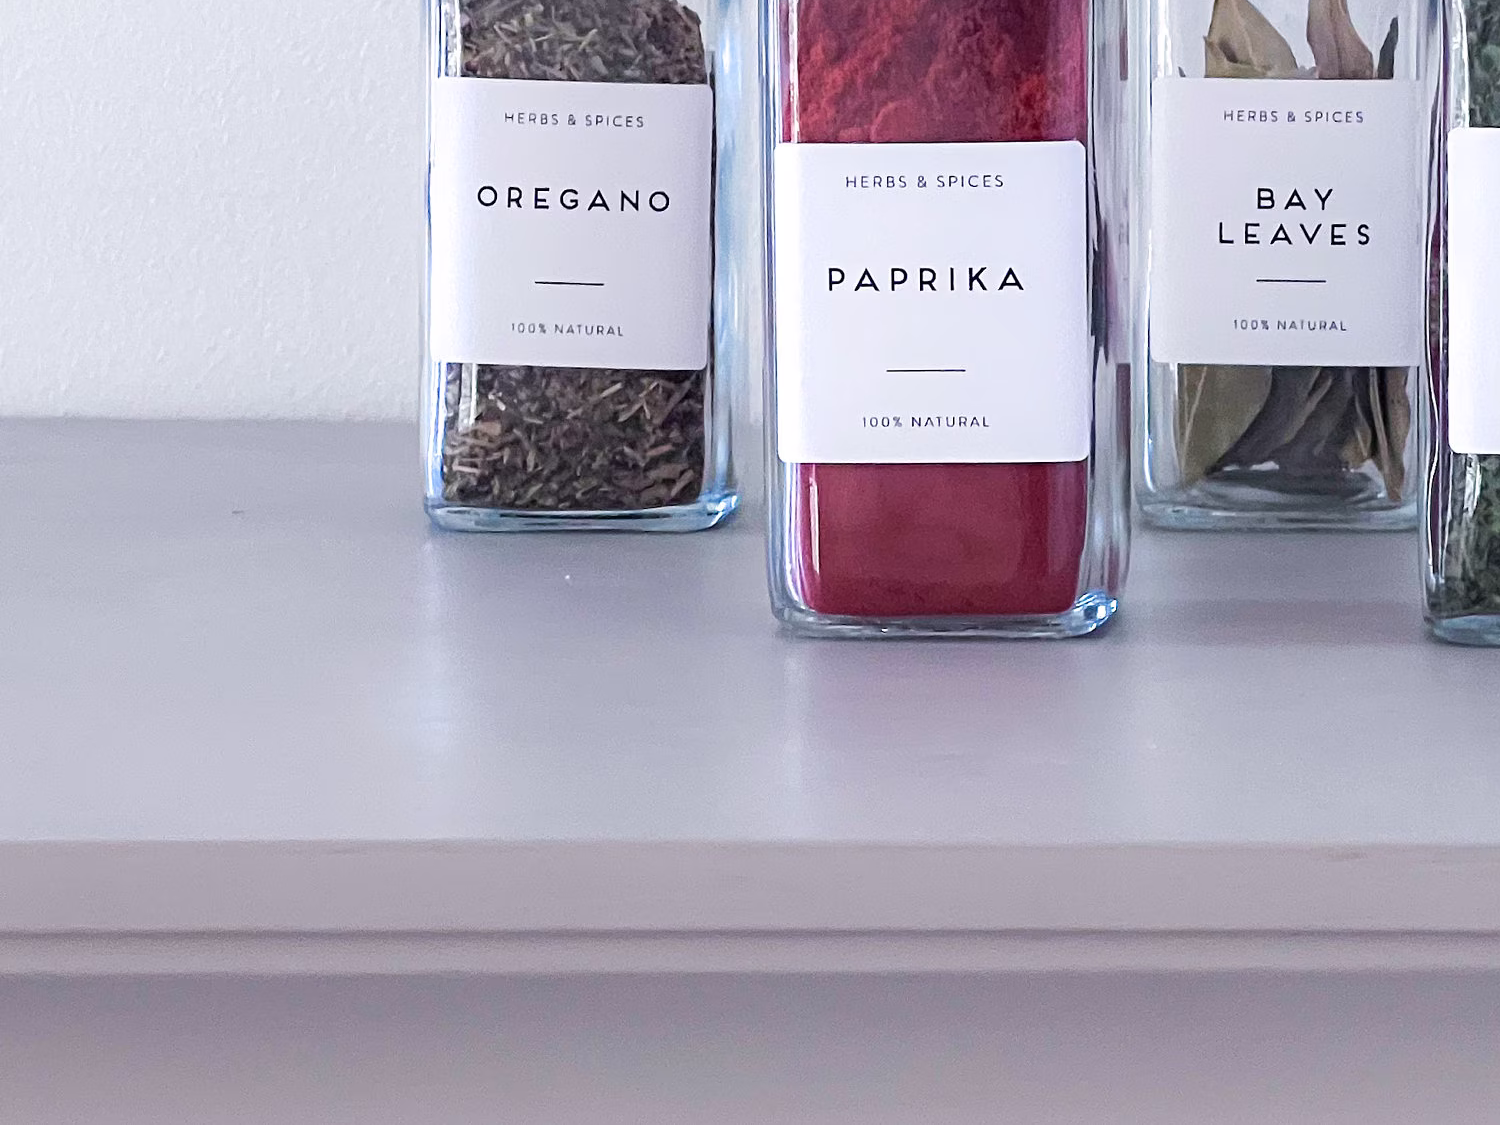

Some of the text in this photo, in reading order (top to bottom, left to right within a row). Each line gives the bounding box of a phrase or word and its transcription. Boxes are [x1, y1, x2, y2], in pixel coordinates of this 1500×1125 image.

[504, 112, 645, 129] HERBS & SPICES
[1223, 109, 1364, 124] HERBS & SPICES
[845, 174, 1004, 189] HERBS & SPICES
[476, 185, 670, 213] OREGANO
[1256, 186, 1334, 212] BAY
[1218, 221, 1371, 247] LEAVES
[827, 266, 1025, 293] PAPRIKA
[511, 322, 624, 338] 100% NATURAL
[1233, 318, 1348, 332] 100% NATURAL
[862, 415, 990, 428] 100% NATURAL
